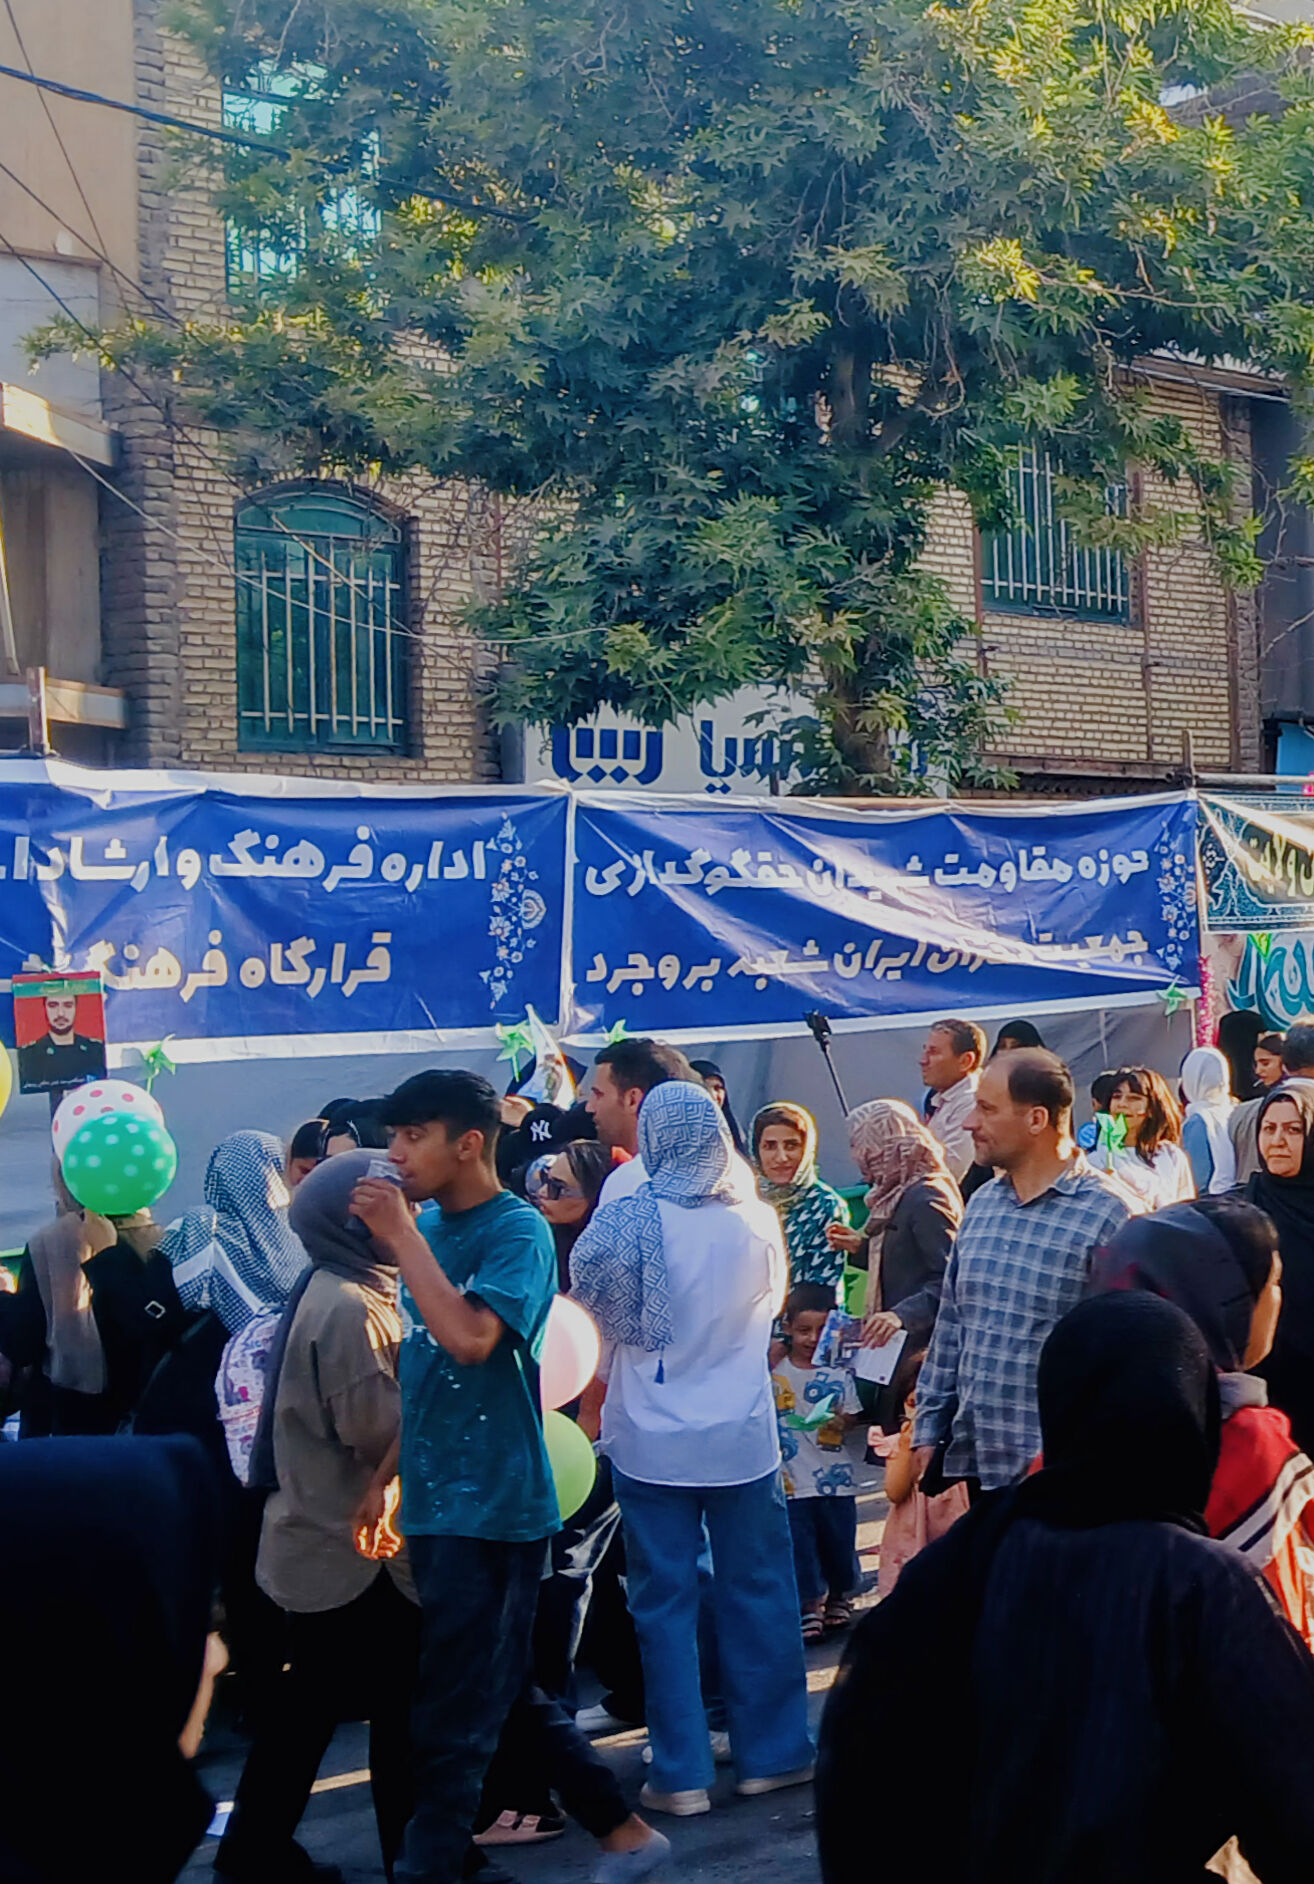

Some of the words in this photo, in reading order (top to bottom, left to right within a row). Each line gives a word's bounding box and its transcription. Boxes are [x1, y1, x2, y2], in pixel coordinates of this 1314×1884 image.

[208, 826, 375, 892] فرهنگ
[381, 840, 487, 893] اداره
[933, 846, 1074, 893] مقاومت
[1077, 849, 1150, 886] حوزه
[239, 931, 393, 999] قرارگاه
[586, 951, 722, 996] بروجرد
[832, 938, 928, 981] ایران
